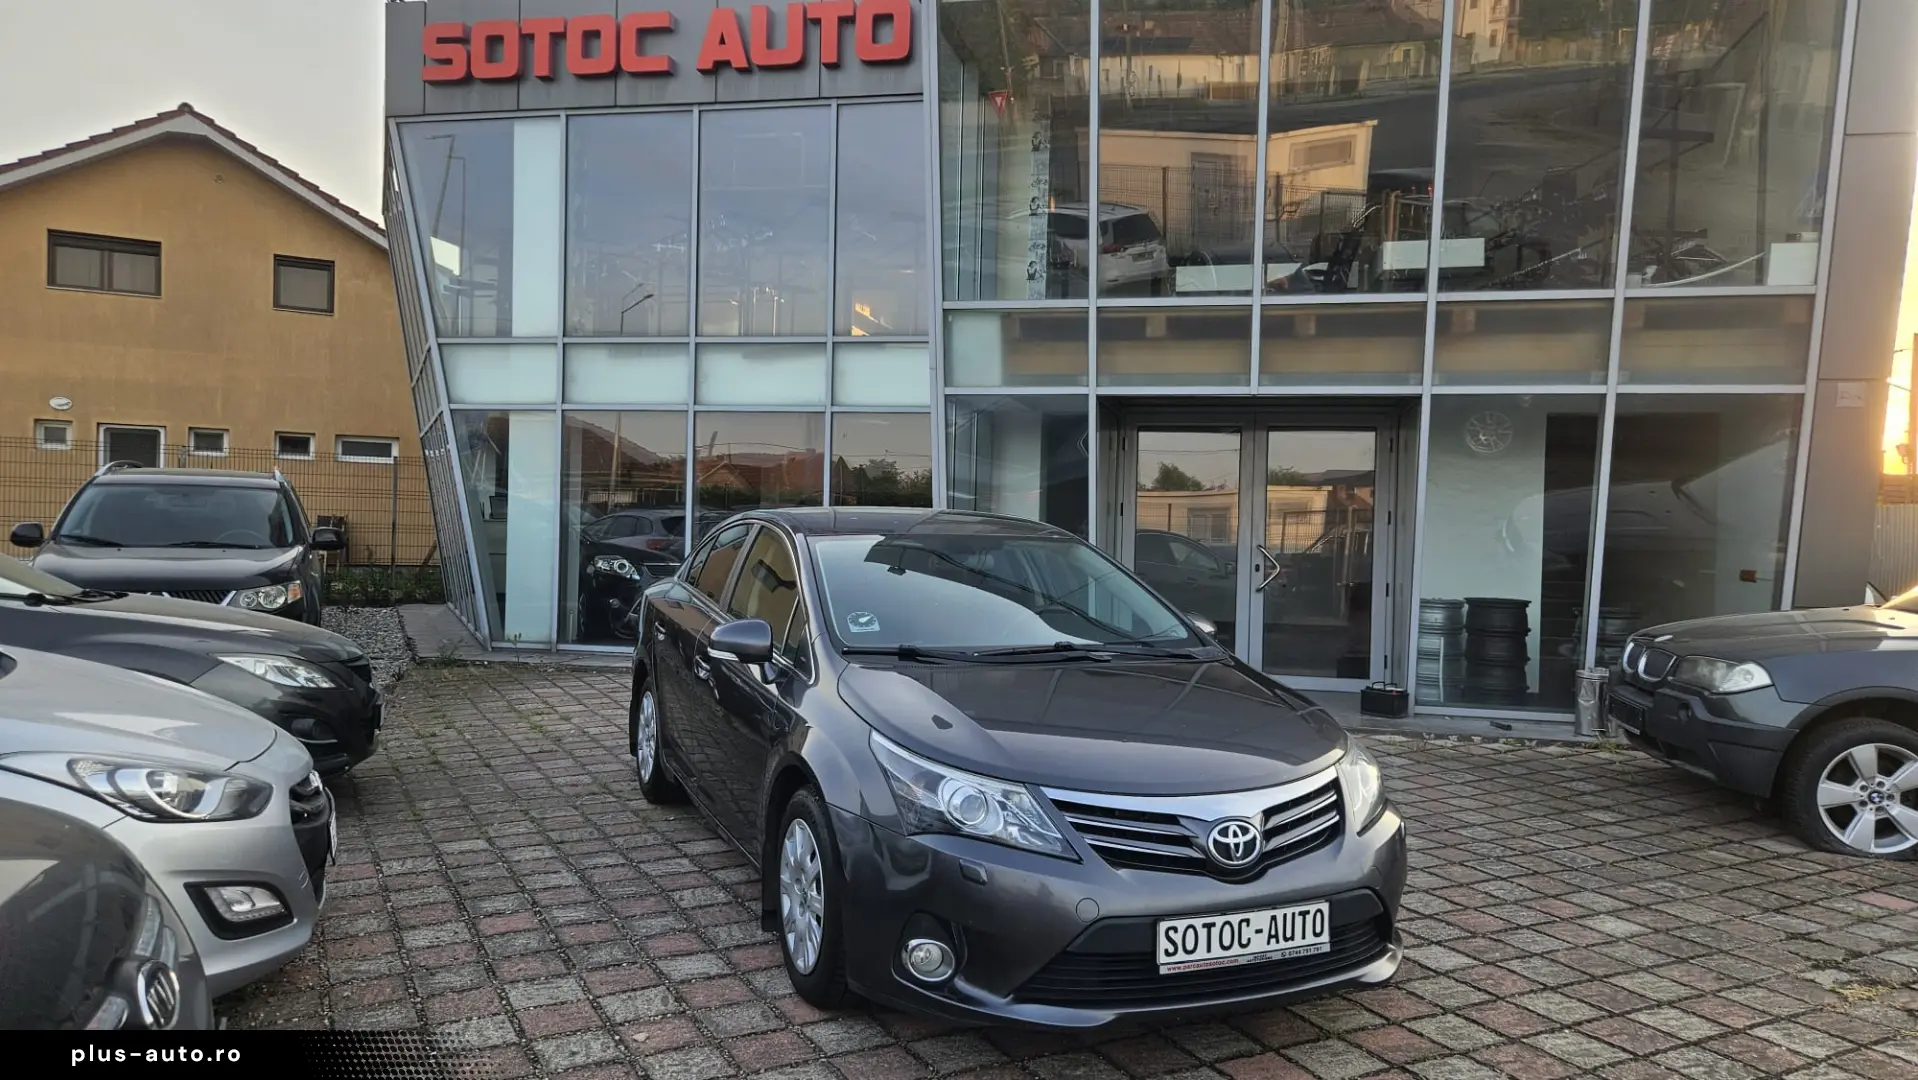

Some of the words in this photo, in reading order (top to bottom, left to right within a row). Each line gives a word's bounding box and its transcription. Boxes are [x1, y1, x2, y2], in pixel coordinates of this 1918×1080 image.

[421, 12, 674, 84] SOTOC
[696, 0, 913, 75] AUTO
[1164, 908, 1325, 958] SOTOC-AUTO
